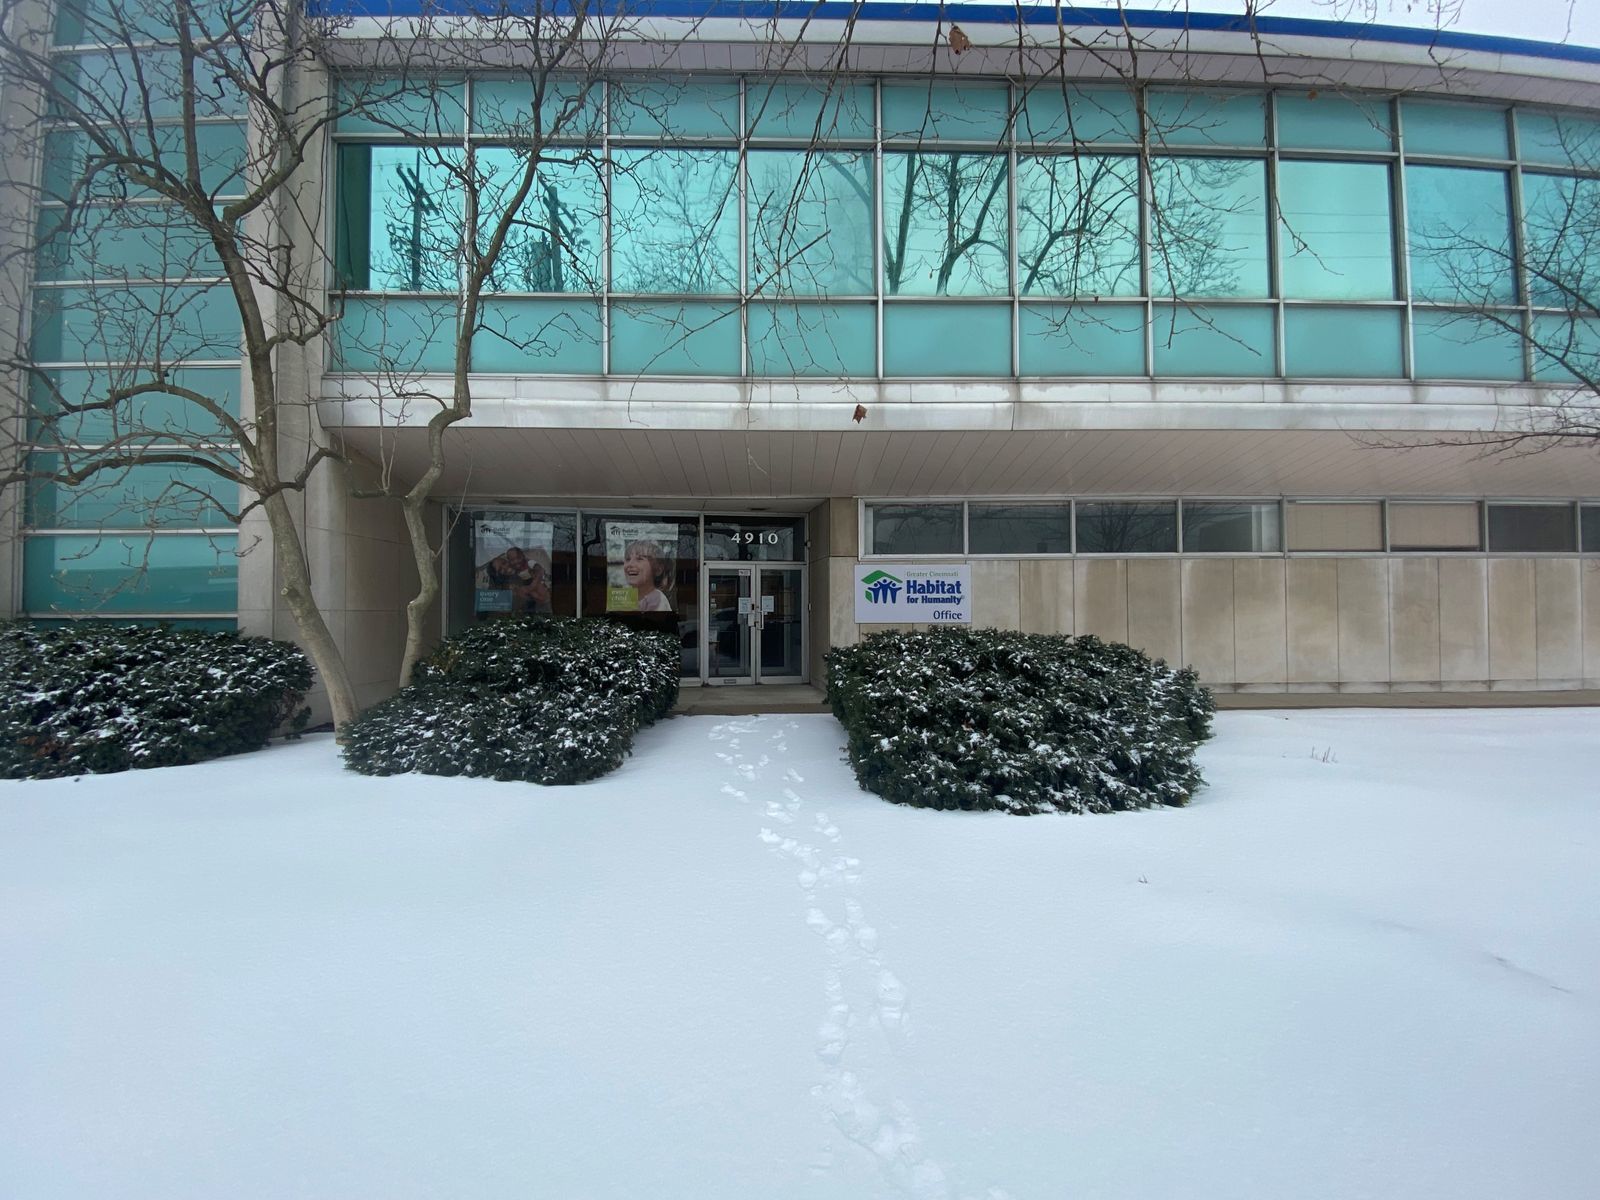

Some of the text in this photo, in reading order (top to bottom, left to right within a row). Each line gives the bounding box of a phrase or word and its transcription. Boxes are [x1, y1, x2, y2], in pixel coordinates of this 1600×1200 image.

[731, 532, 778, 544] 4910
[906, 580, 962, 594] Habitat
[906, 595, 919, 604] for
[933, 610, 963, 620] Office
